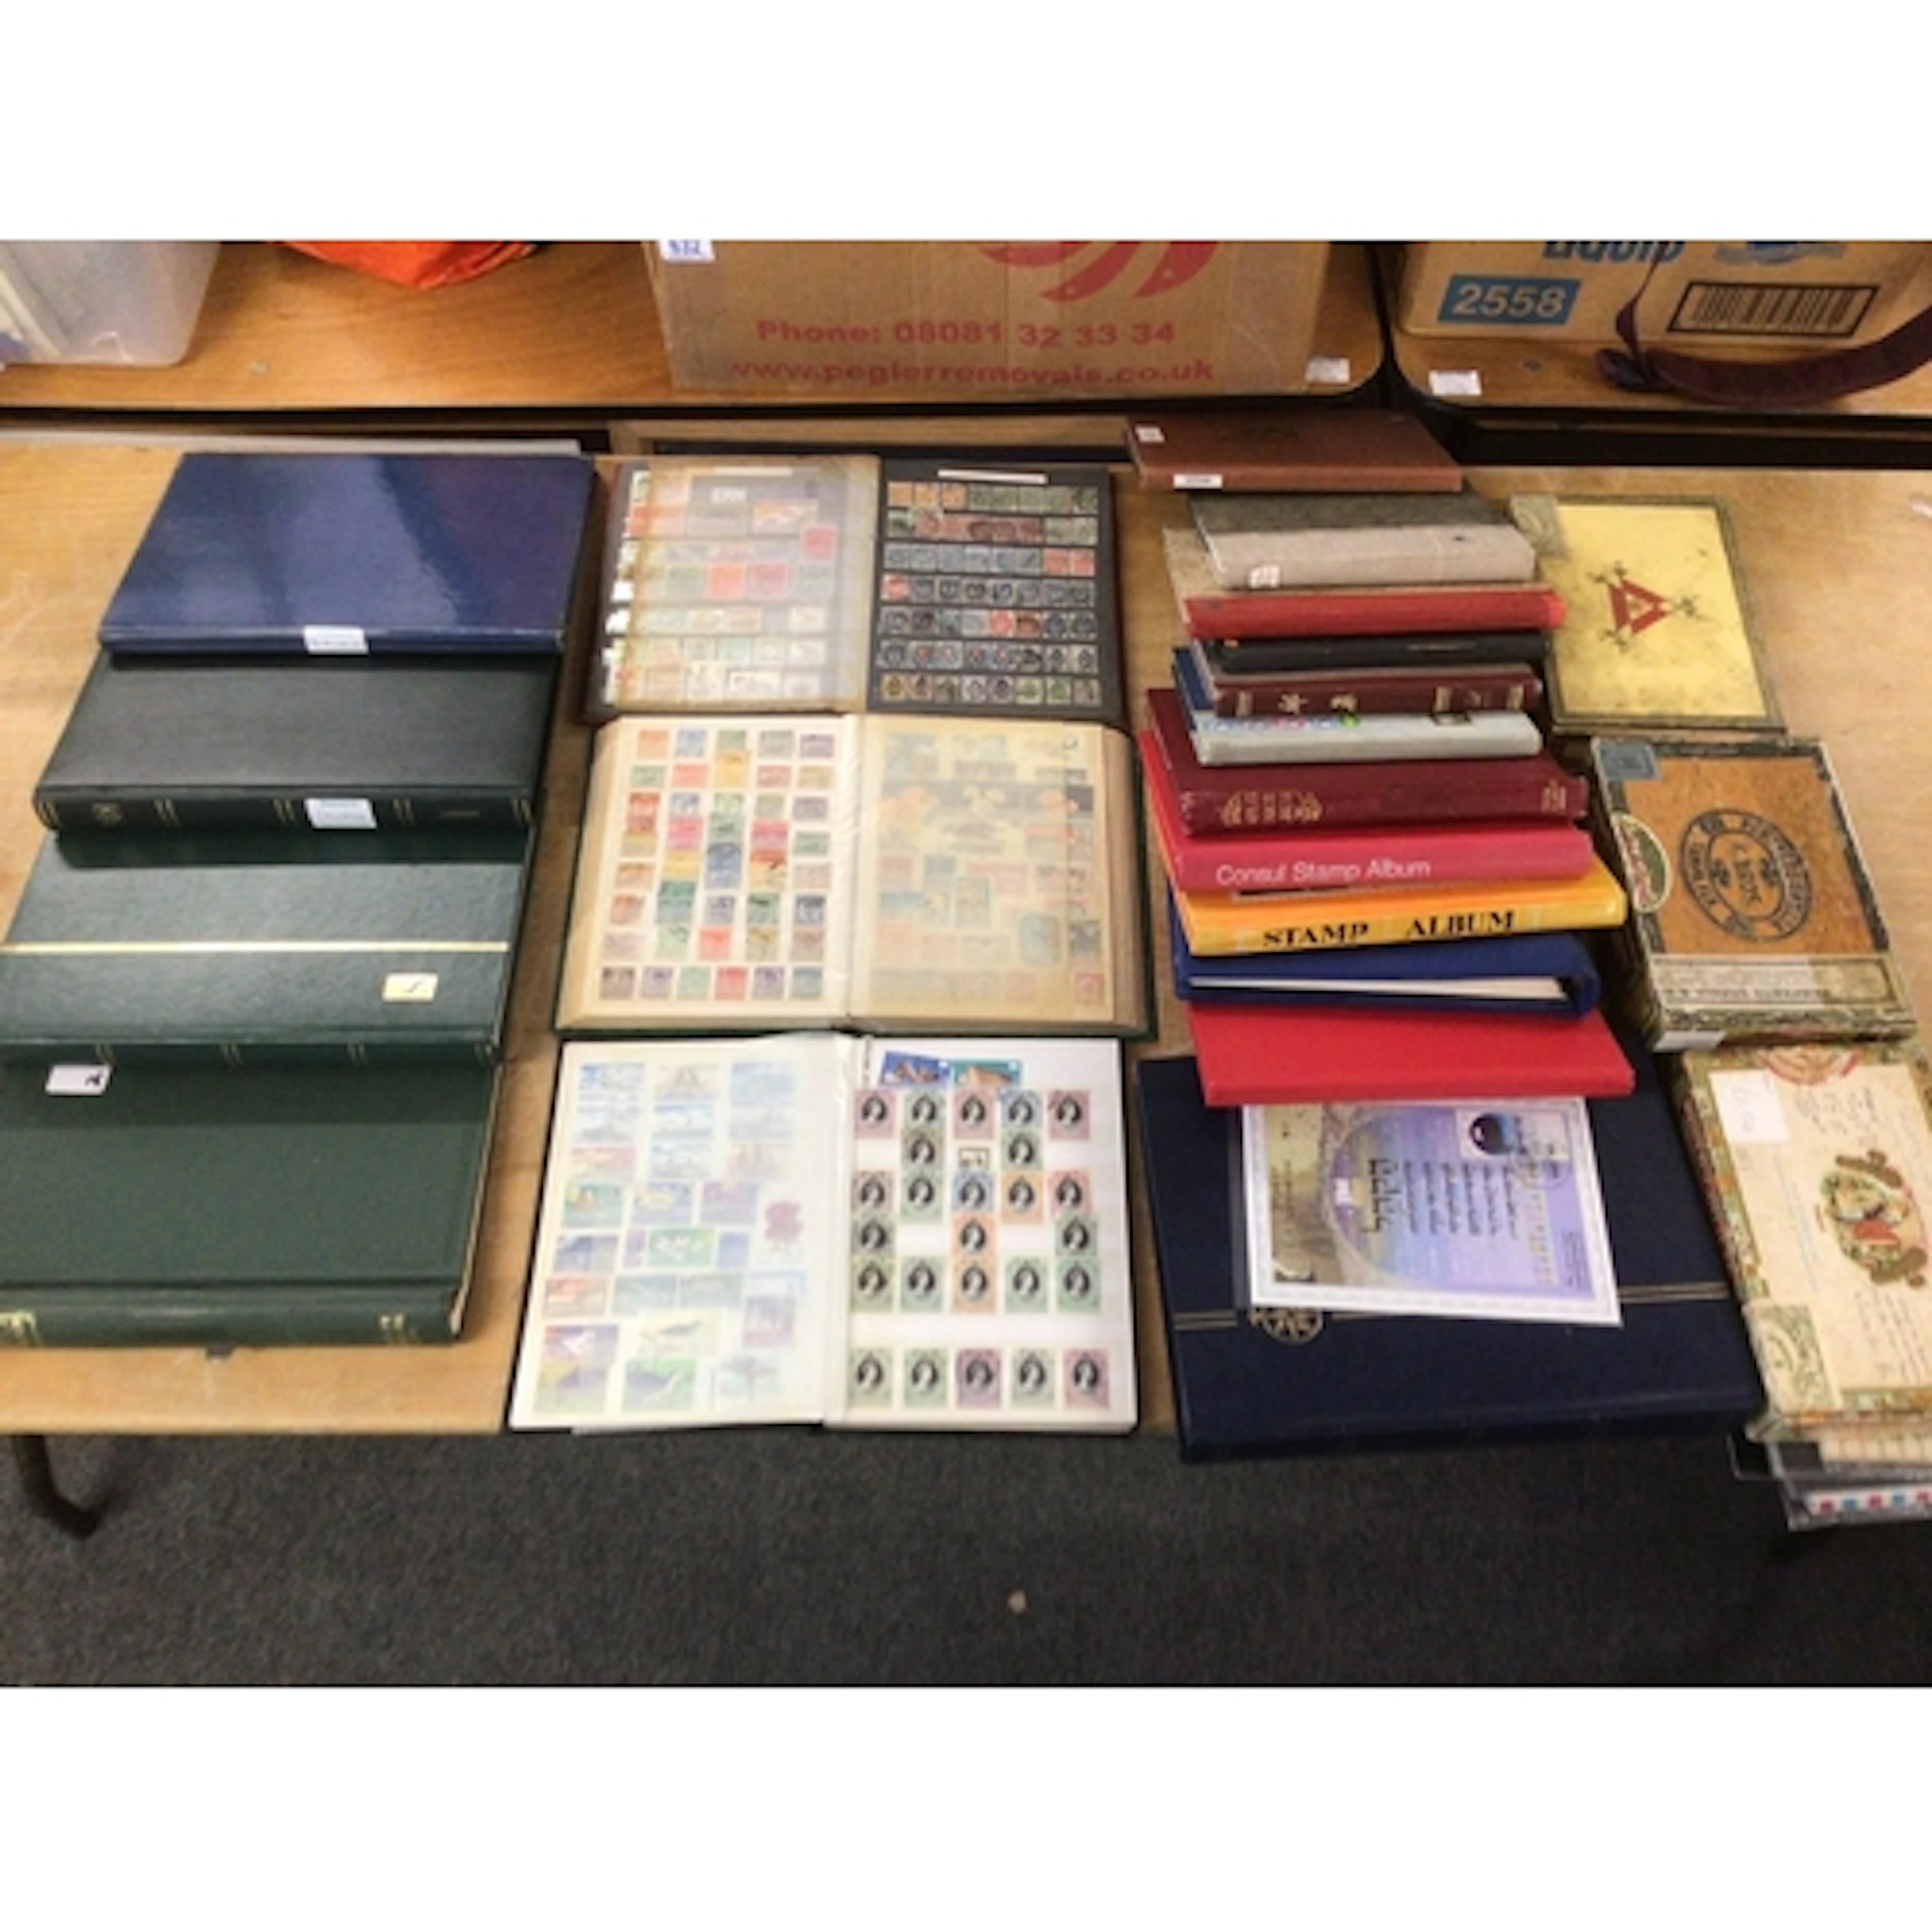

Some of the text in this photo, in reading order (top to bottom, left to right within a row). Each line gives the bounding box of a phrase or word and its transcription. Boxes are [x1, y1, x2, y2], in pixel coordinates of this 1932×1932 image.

[1452, 282, 1566, 318] 2558
[757, 320, 1176, 348] Phone: 08081 32 33 34
[1215, 857, 1432, 886] Consul Stamp Album
[1262, 910, 1514, 948] STAMP ALBUM
